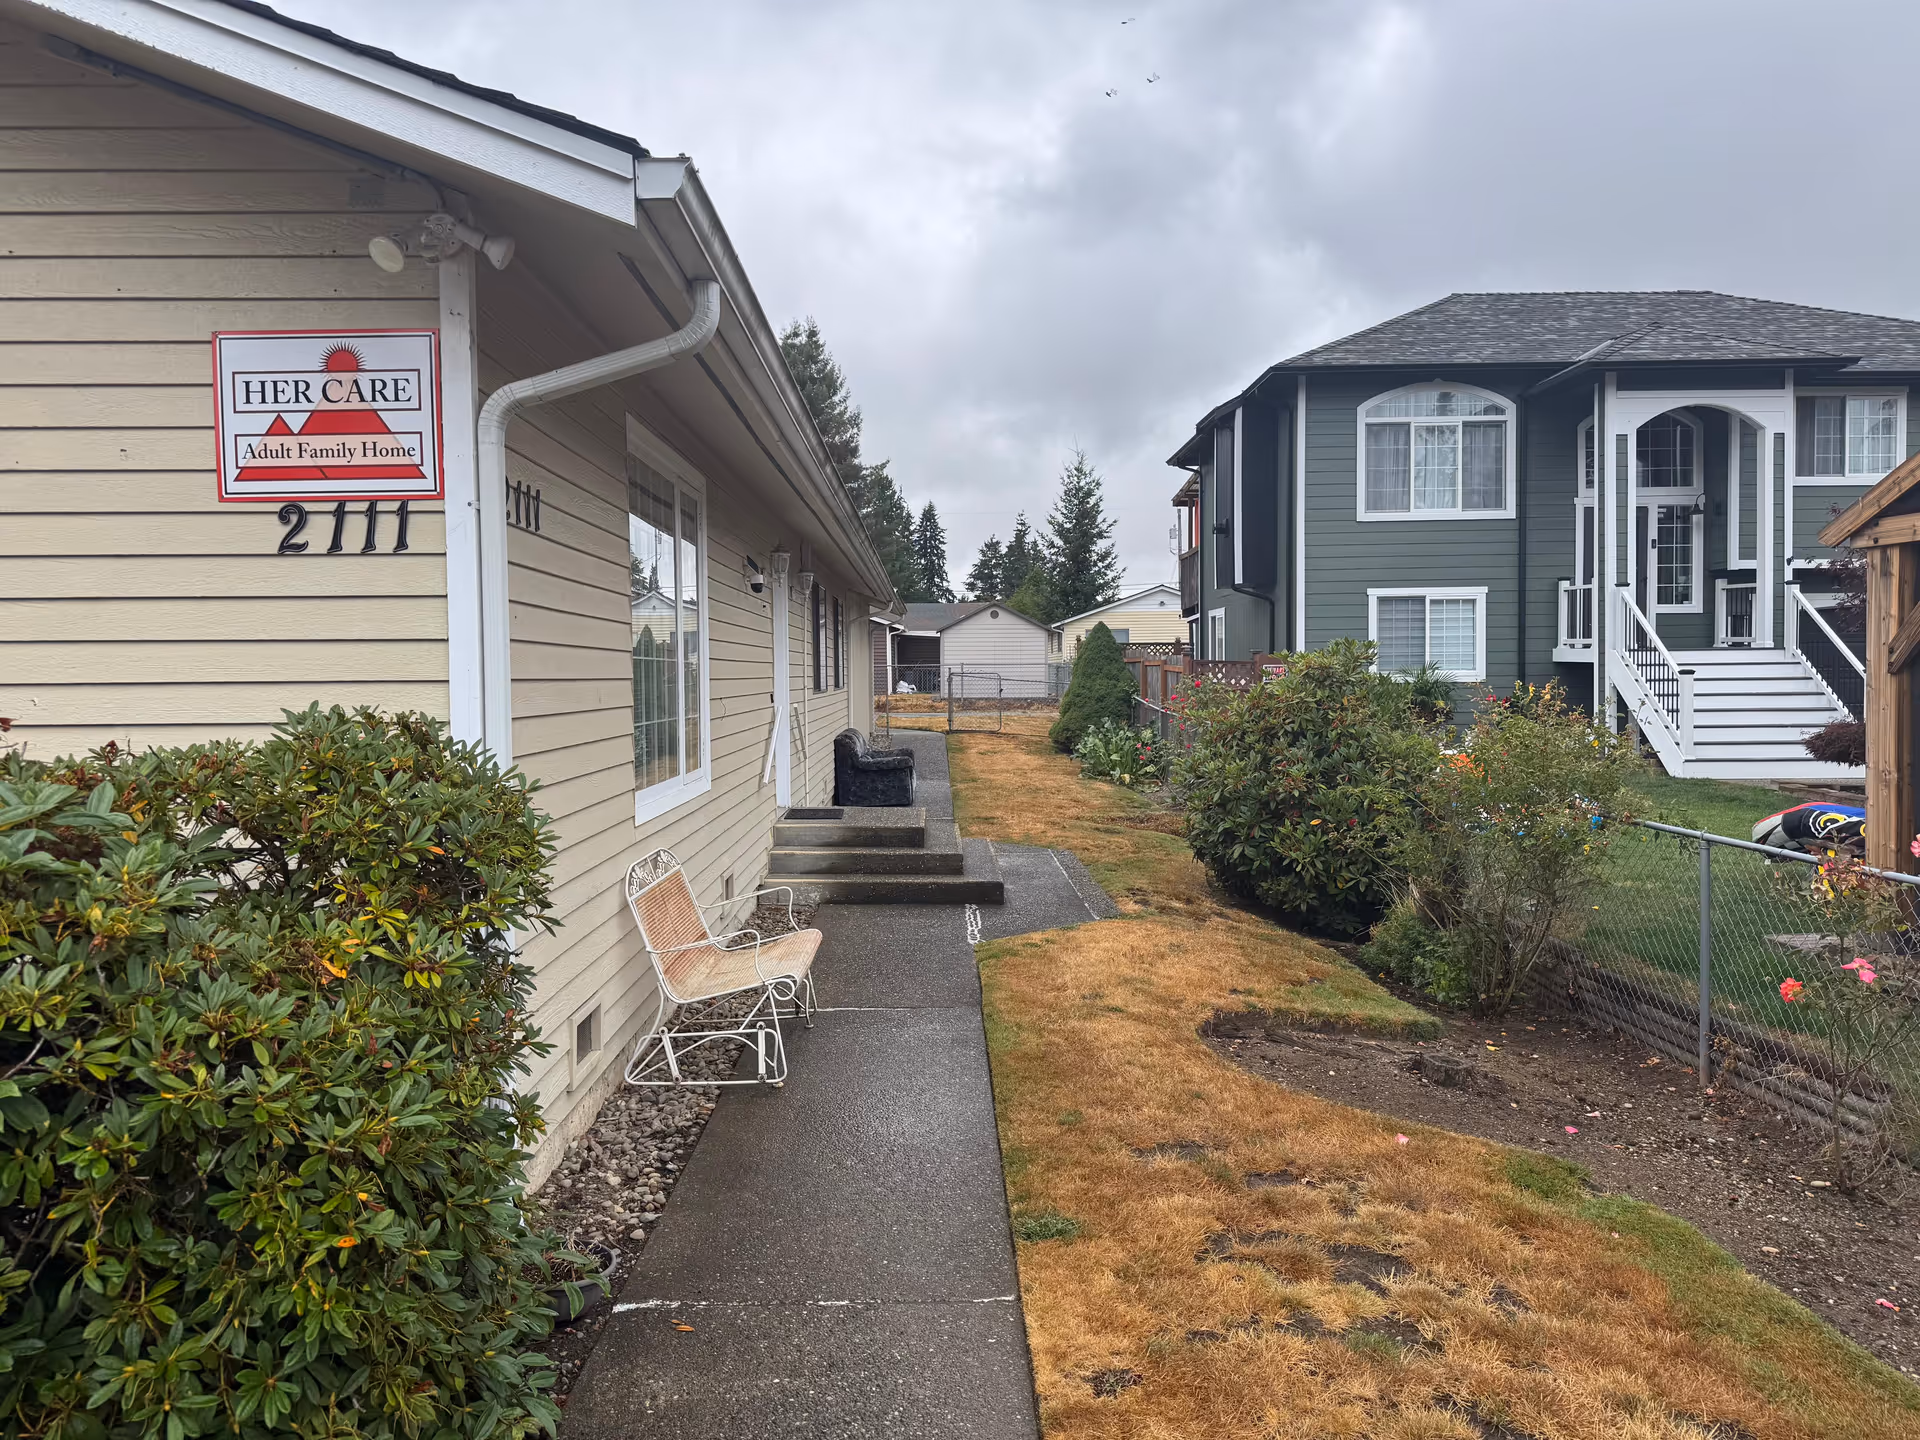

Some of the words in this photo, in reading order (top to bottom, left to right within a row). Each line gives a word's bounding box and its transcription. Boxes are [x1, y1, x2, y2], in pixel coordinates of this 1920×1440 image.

[242, 379, 314, 404] HER
[322, 378, 412, 404] CARE
[242, 443, 292, 460] Adult
[297, 442, 357, 463] Family
[361, 441, 416, 459] Home
[277, 500, 409, 554] 2111
